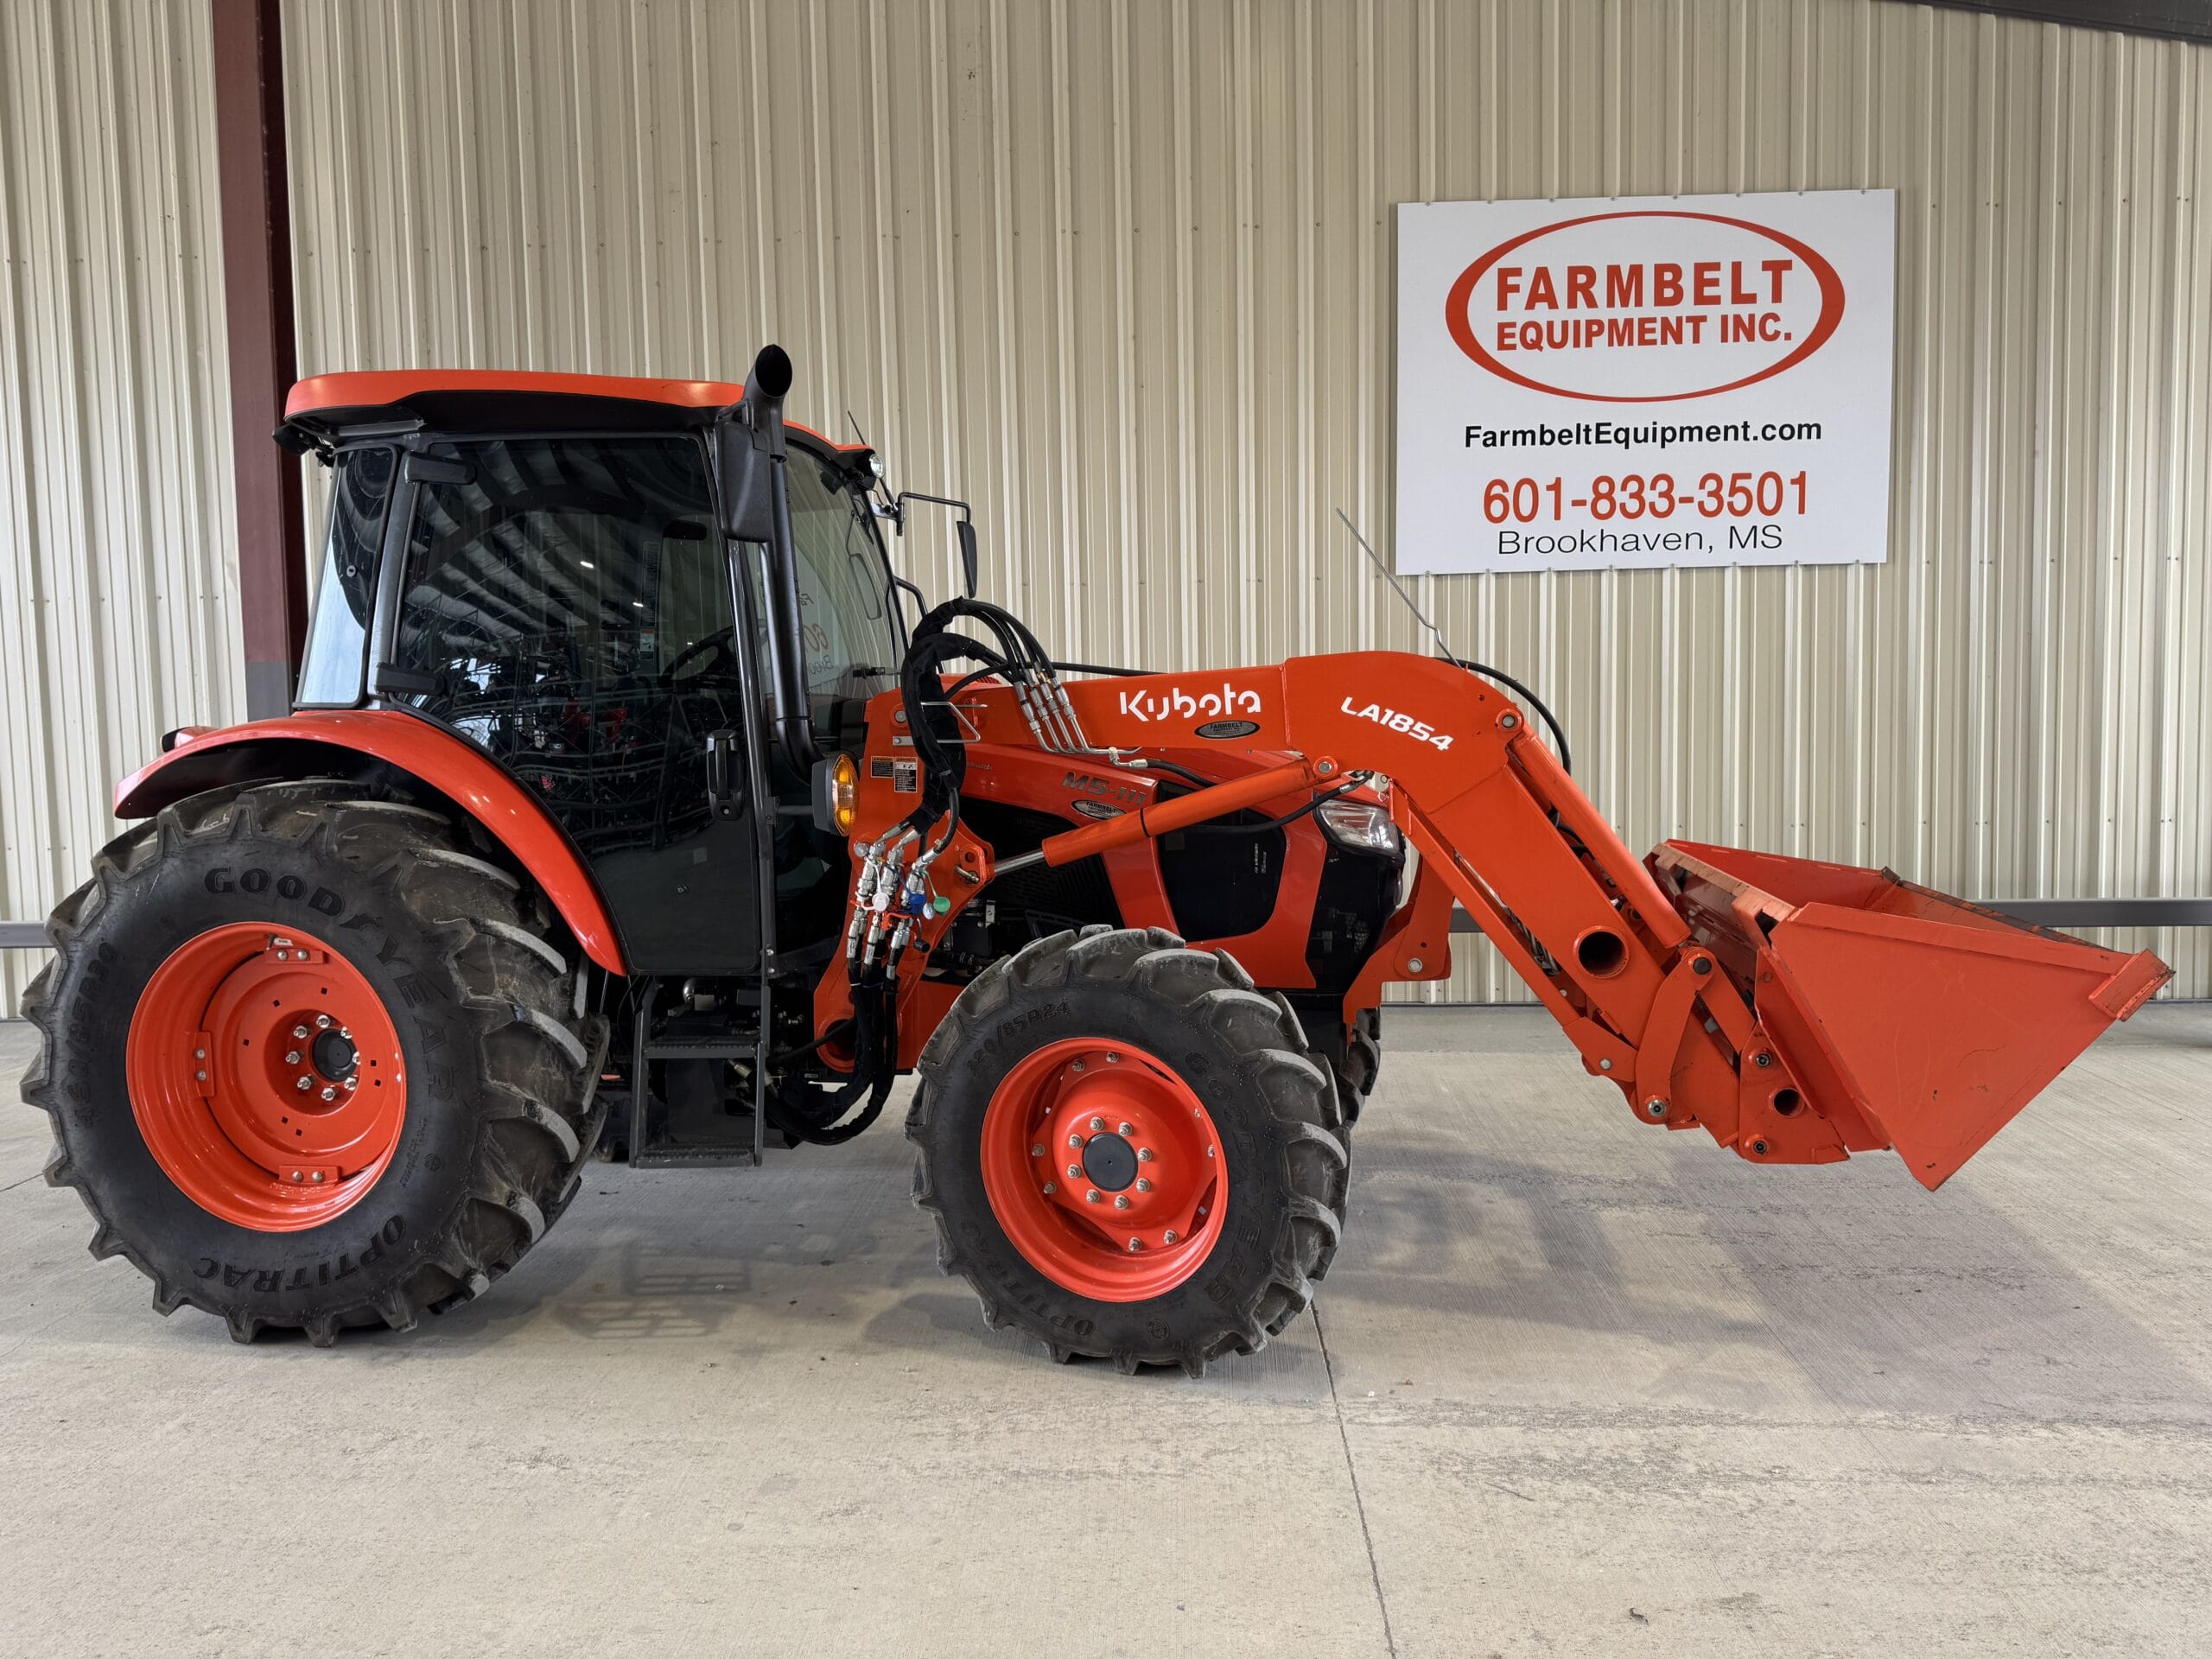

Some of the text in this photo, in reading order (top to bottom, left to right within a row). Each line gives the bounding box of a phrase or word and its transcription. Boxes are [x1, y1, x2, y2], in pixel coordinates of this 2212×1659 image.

[1497, 259, 1793, 311] FARMBELT
[1497, 312, 1792, 352] EQUIPMENT INC.
[1465, 421, 1822, 449] FarmbeltEquipment.com
[1483, 471, 1807, 524] 601-833-3501
[1498, 524, 1783, 555] Brookhaven, MS
[1120, 683, 1262, 721] Kubota
[1340, 696, 1454, 751] LA1854
[193, 1215, 407, 1294] OPTITRAC
